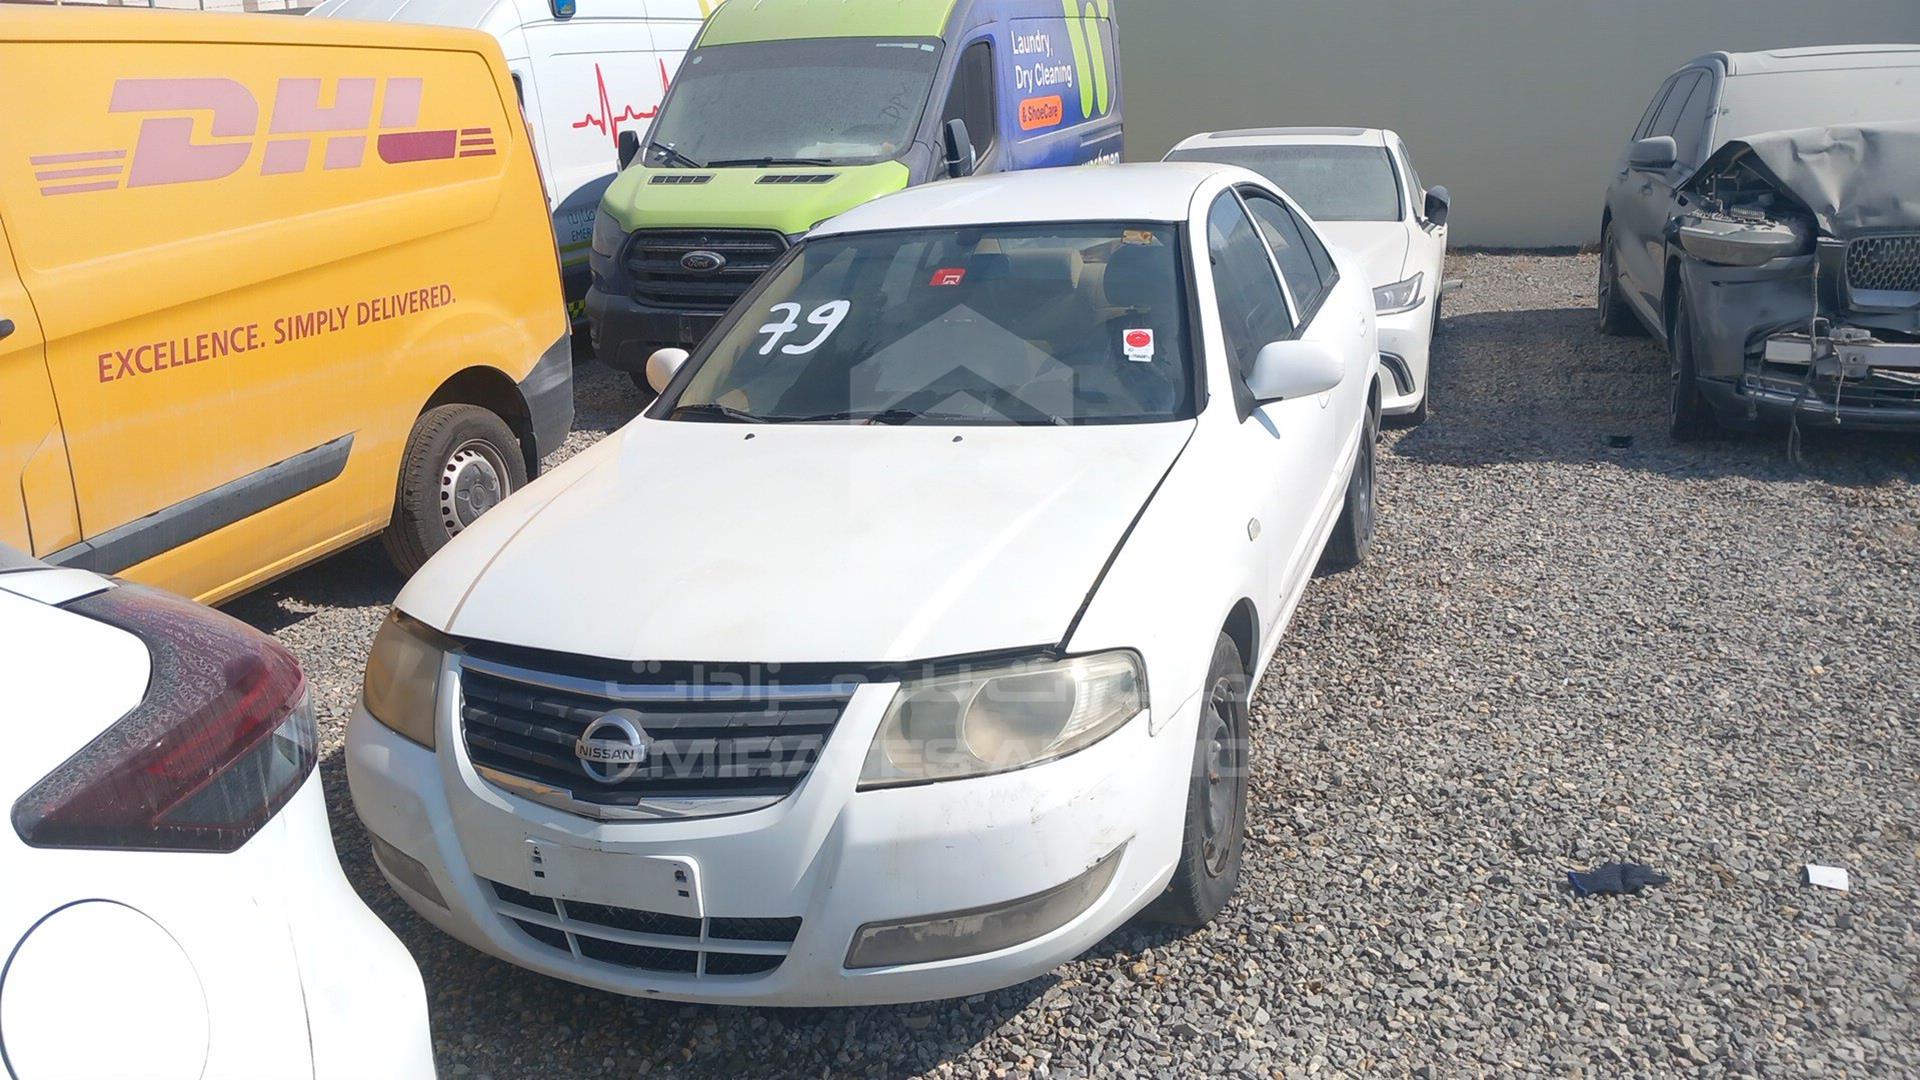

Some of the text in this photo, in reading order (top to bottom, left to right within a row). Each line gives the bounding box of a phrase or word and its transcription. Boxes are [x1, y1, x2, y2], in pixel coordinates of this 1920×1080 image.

[1011, 30, 1053, 58] Laundry,
[1015, 60, 1073, 93] Dry Cleaning
[1022, 103, 1058, 122] & ShoeCare
[107, 77, 457, 188] DHL
[98, 283, 456, 383] EXCELLENCE. SIMPLY DELIVERED.
[759, 299, 851, 355] 79
[579, 744, 635, 760] NISSAN
